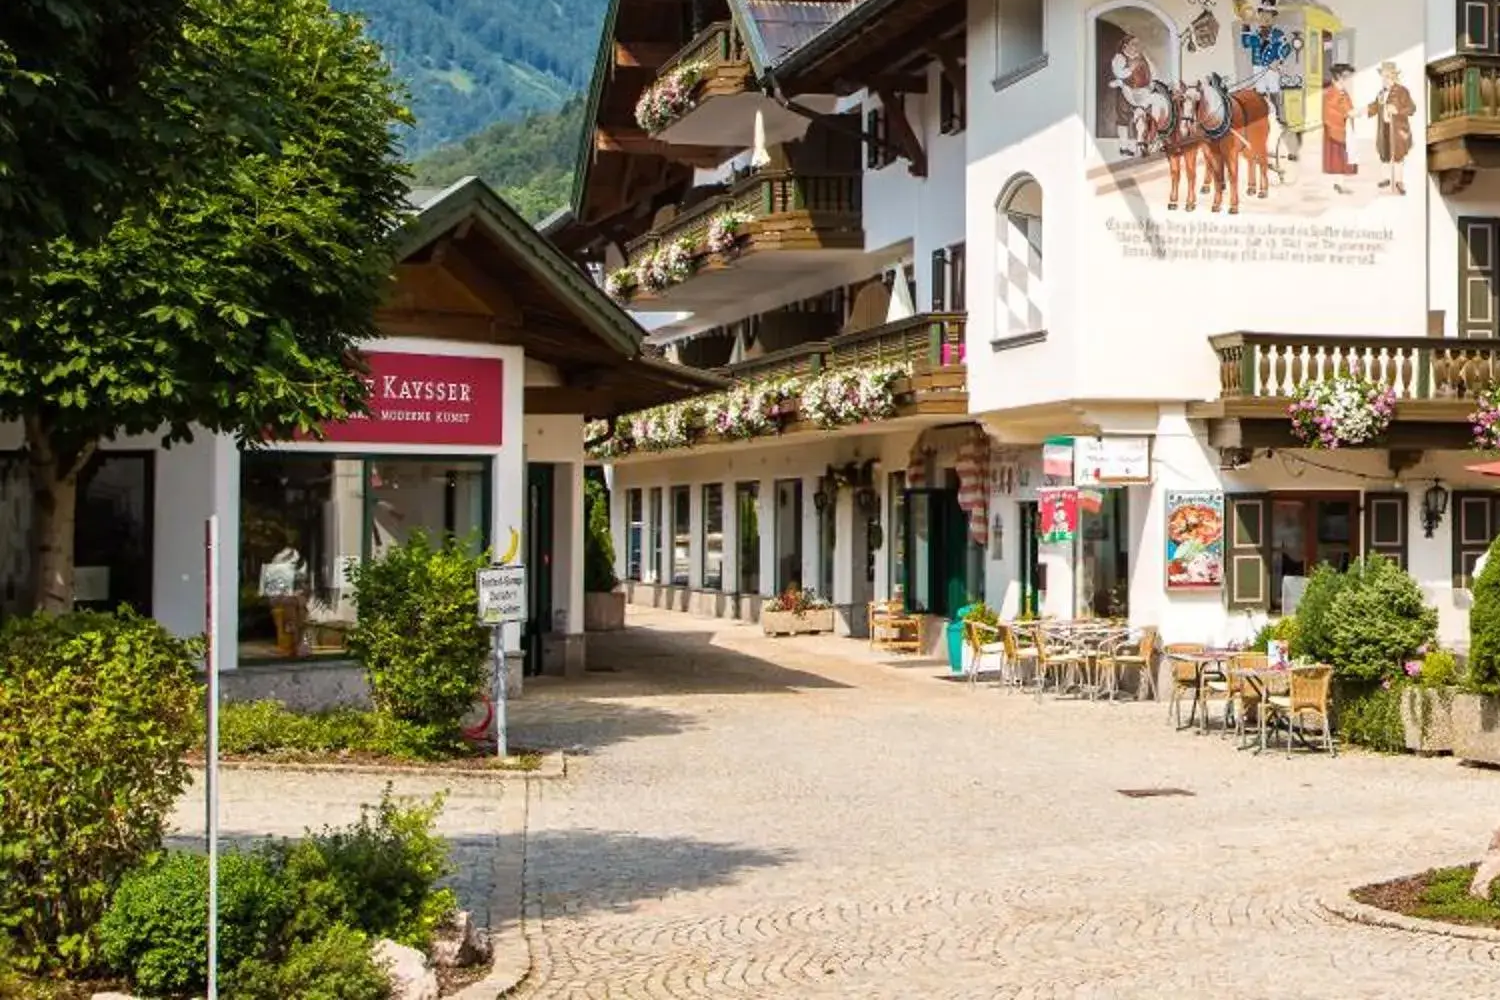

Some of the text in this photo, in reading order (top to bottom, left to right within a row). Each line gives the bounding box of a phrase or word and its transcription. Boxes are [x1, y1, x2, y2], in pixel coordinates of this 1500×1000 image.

[383, 375, 471, 401] KAYSSER
[381, 409, 431, 422] MODERNE
[435, 411, 471, 423] KUNST
